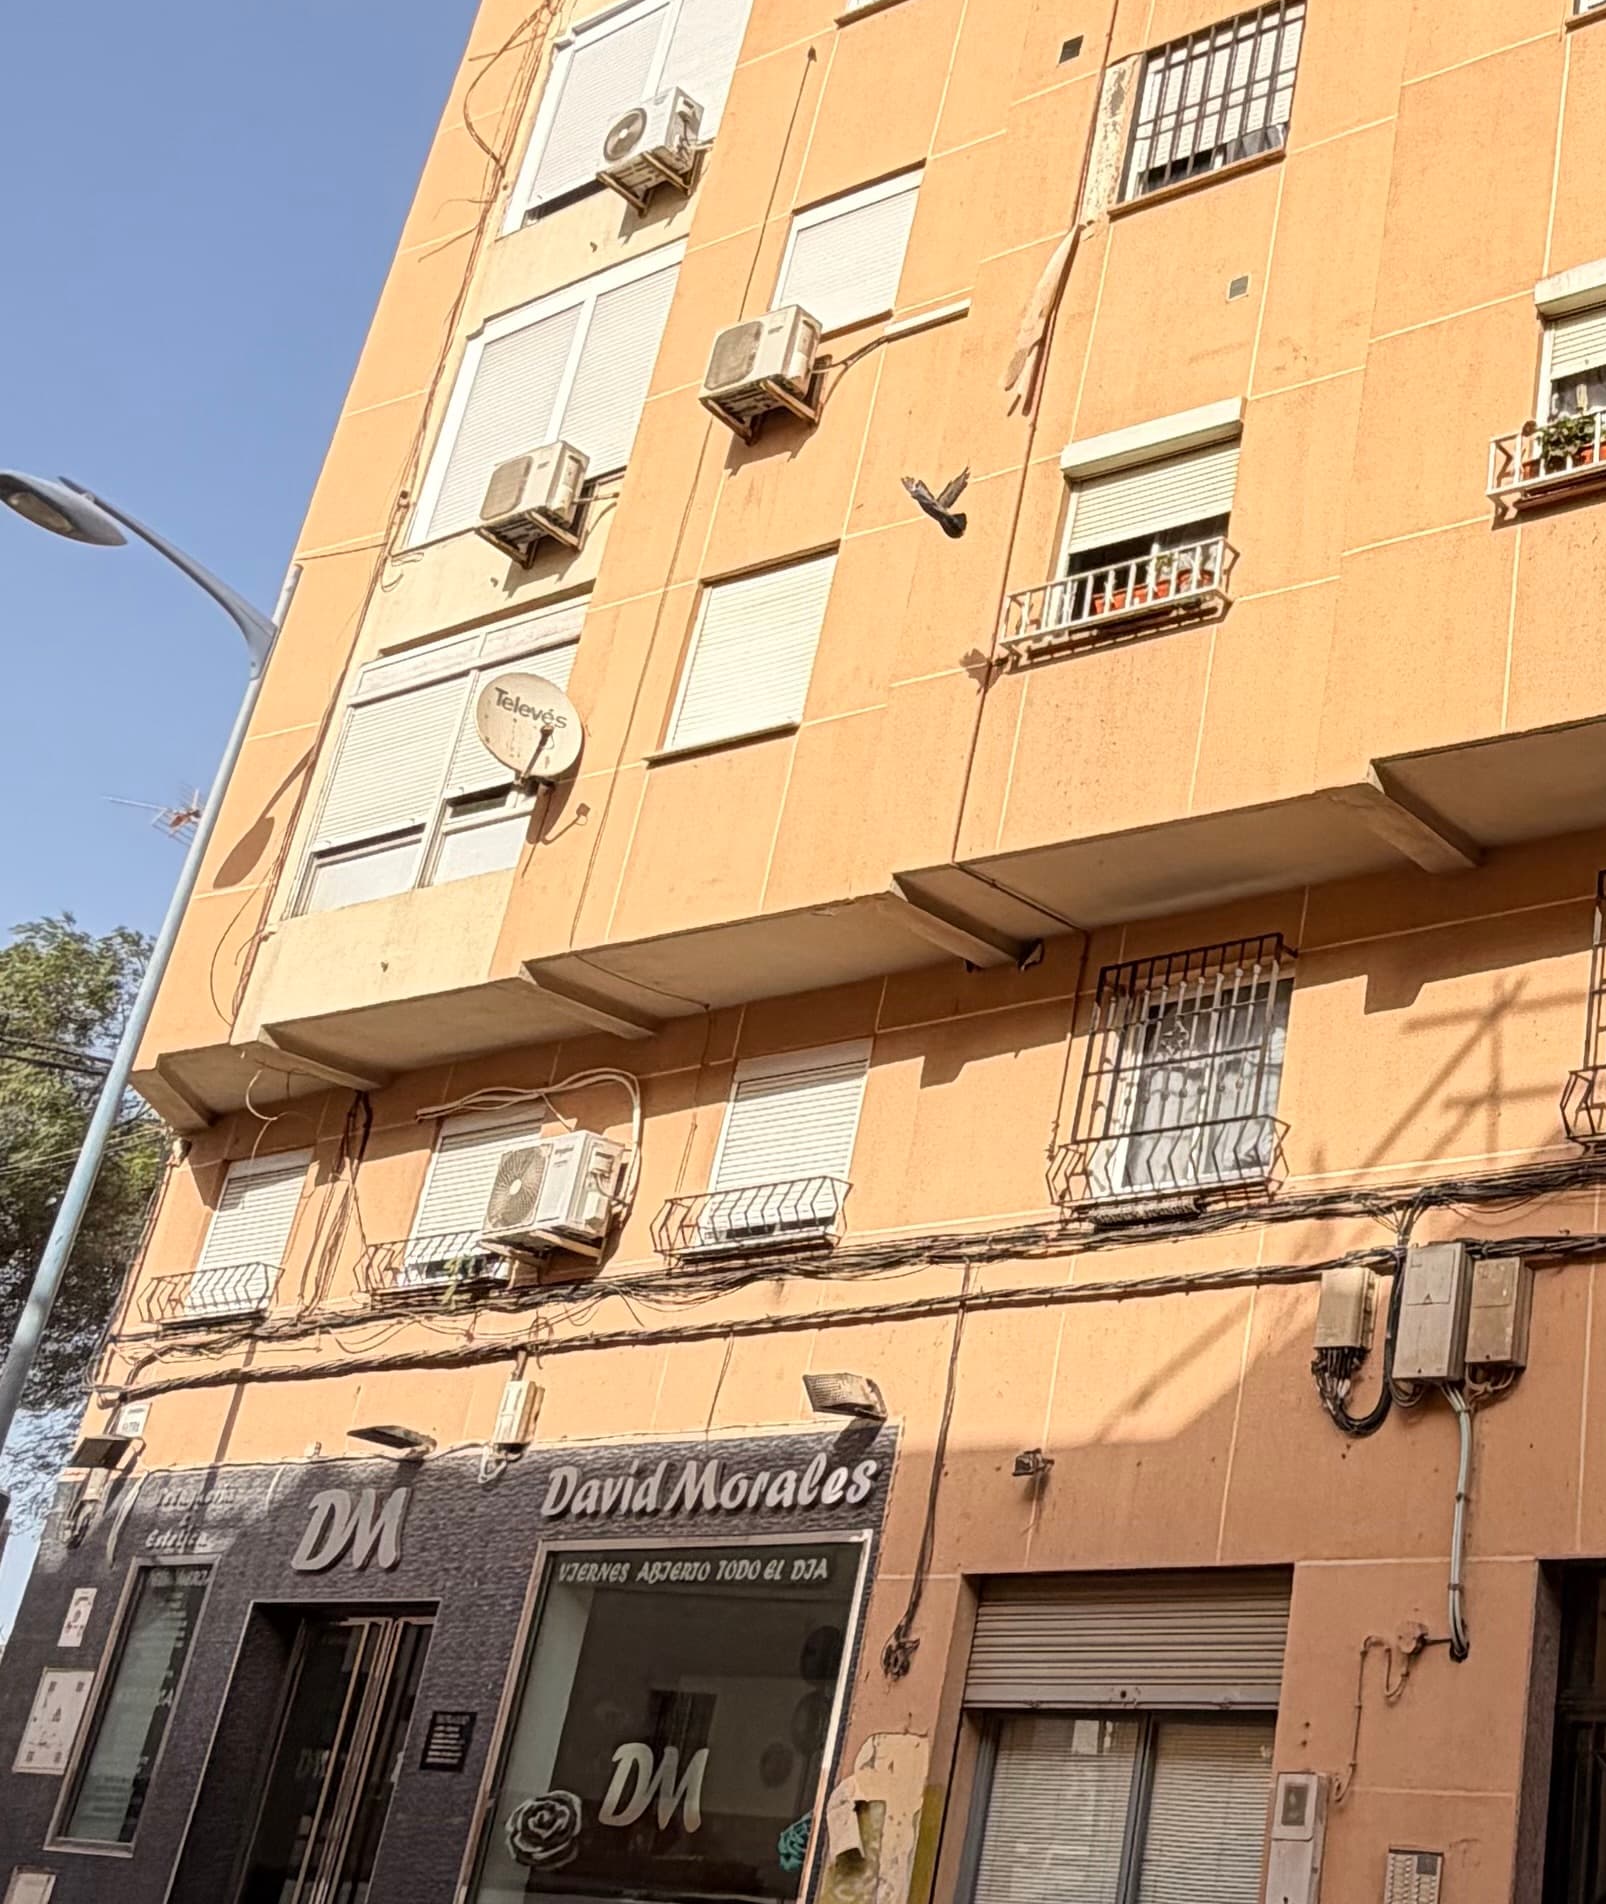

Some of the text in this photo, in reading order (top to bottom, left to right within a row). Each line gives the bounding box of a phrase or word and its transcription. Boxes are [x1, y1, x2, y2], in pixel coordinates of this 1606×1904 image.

[495, 687, 568, 729] Televés
[541, 1453, 877, 1517] David Morales
[292, 1487, 408, 1571] DM
[558, 1557, 829, 1585] VIERNES ABIERTO TODO EL DIA
[598, 1742, 709, 1833] DM
